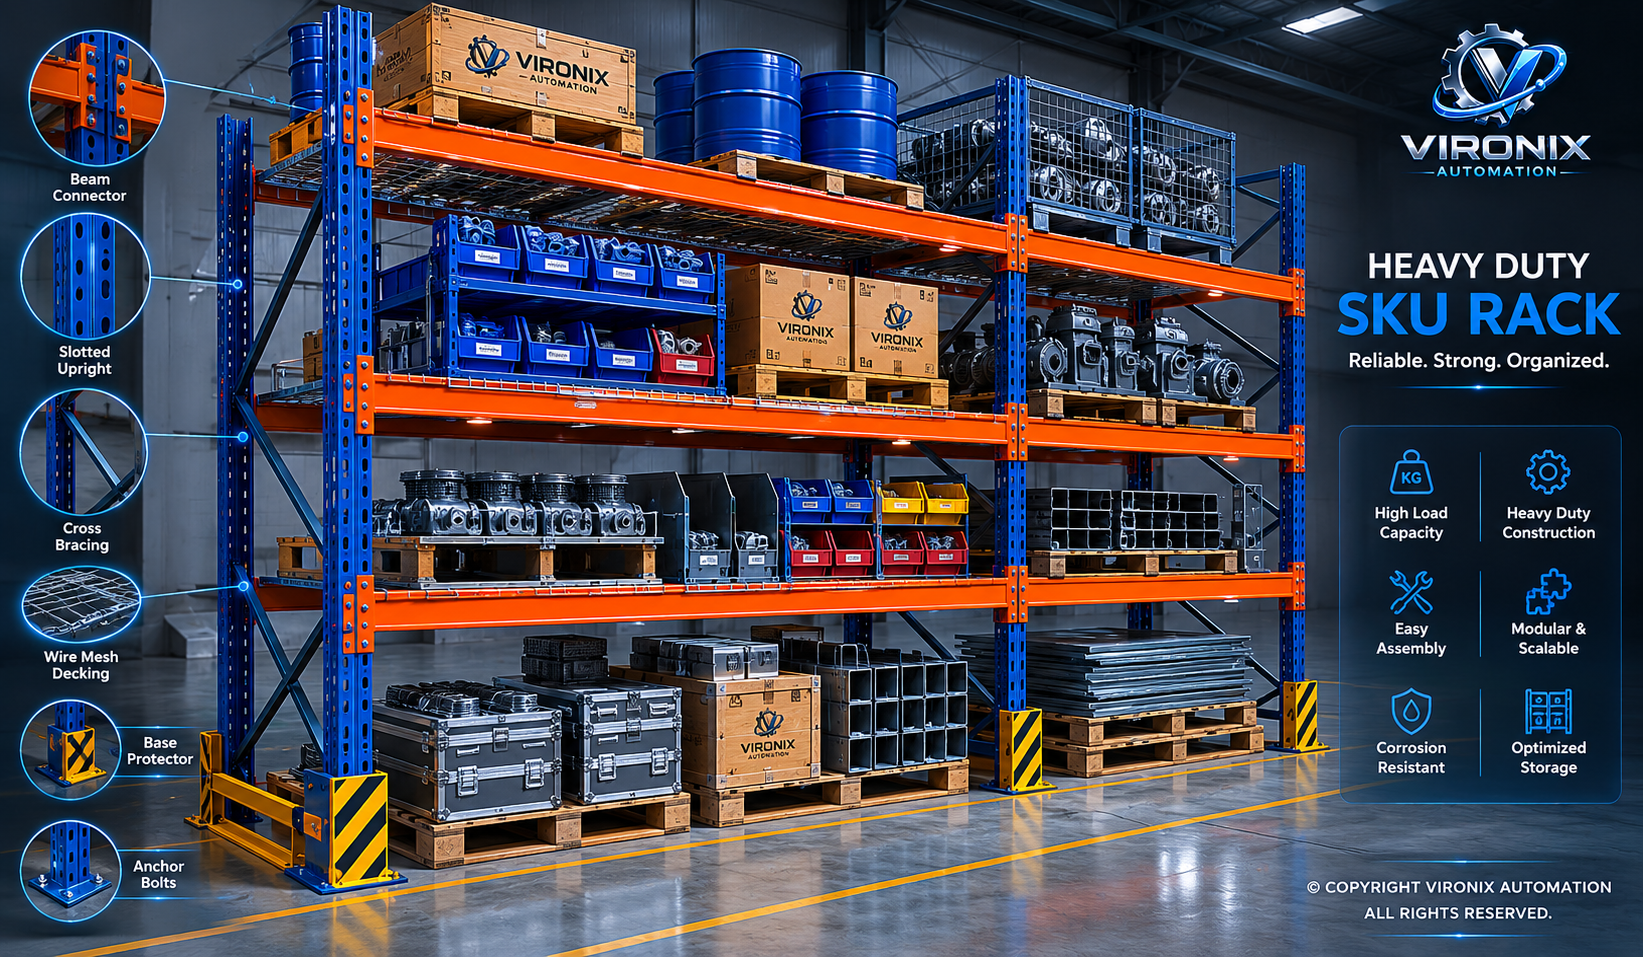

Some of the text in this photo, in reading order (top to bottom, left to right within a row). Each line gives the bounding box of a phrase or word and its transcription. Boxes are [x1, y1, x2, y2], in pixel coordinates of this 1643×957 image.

[516, 51, 610, 87] VIRONIX
[530, 75, 598, 95] AUTOMATION
[777, 321, 835, 339] VIRONIX
[870, 331, 923, 348] VIRONIX
[740, 739, 796, 754] VIRONIX
